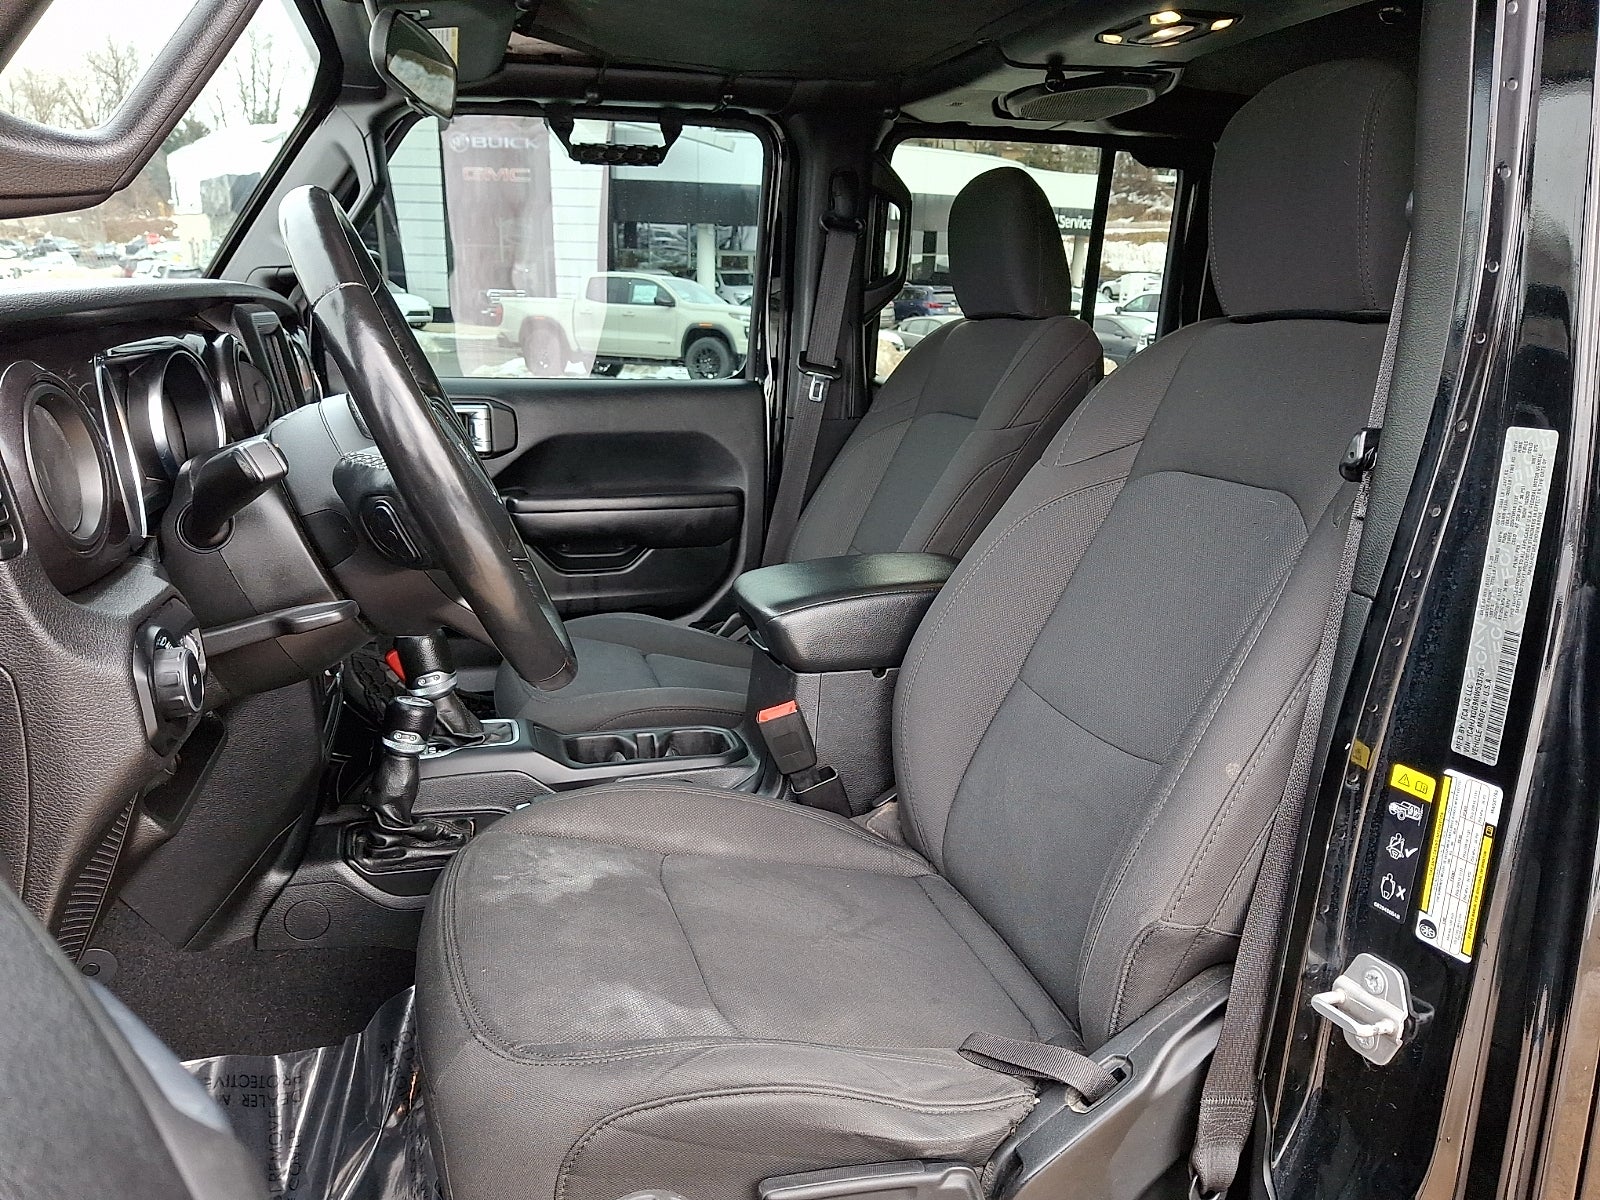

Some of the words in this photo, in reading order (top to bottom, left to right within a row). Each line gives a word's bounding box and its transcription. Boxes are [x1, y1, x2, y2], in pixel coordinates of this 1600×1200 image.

[471, 136, 541, 149] BUICK
[462, 166, 532, 183] GMC
[1058, 214, 1093, 230] Service
[1464, 697, 1471, 707] US
[1461, 707, 1469, 721] FCA
[1477, 709, 1487, 729] MADE
[1472, 729, 1483, 757] VEHICLE
[242, 1088, 303, 1108] DEALER
[267, 1111, 284, 1182] REMOVE
